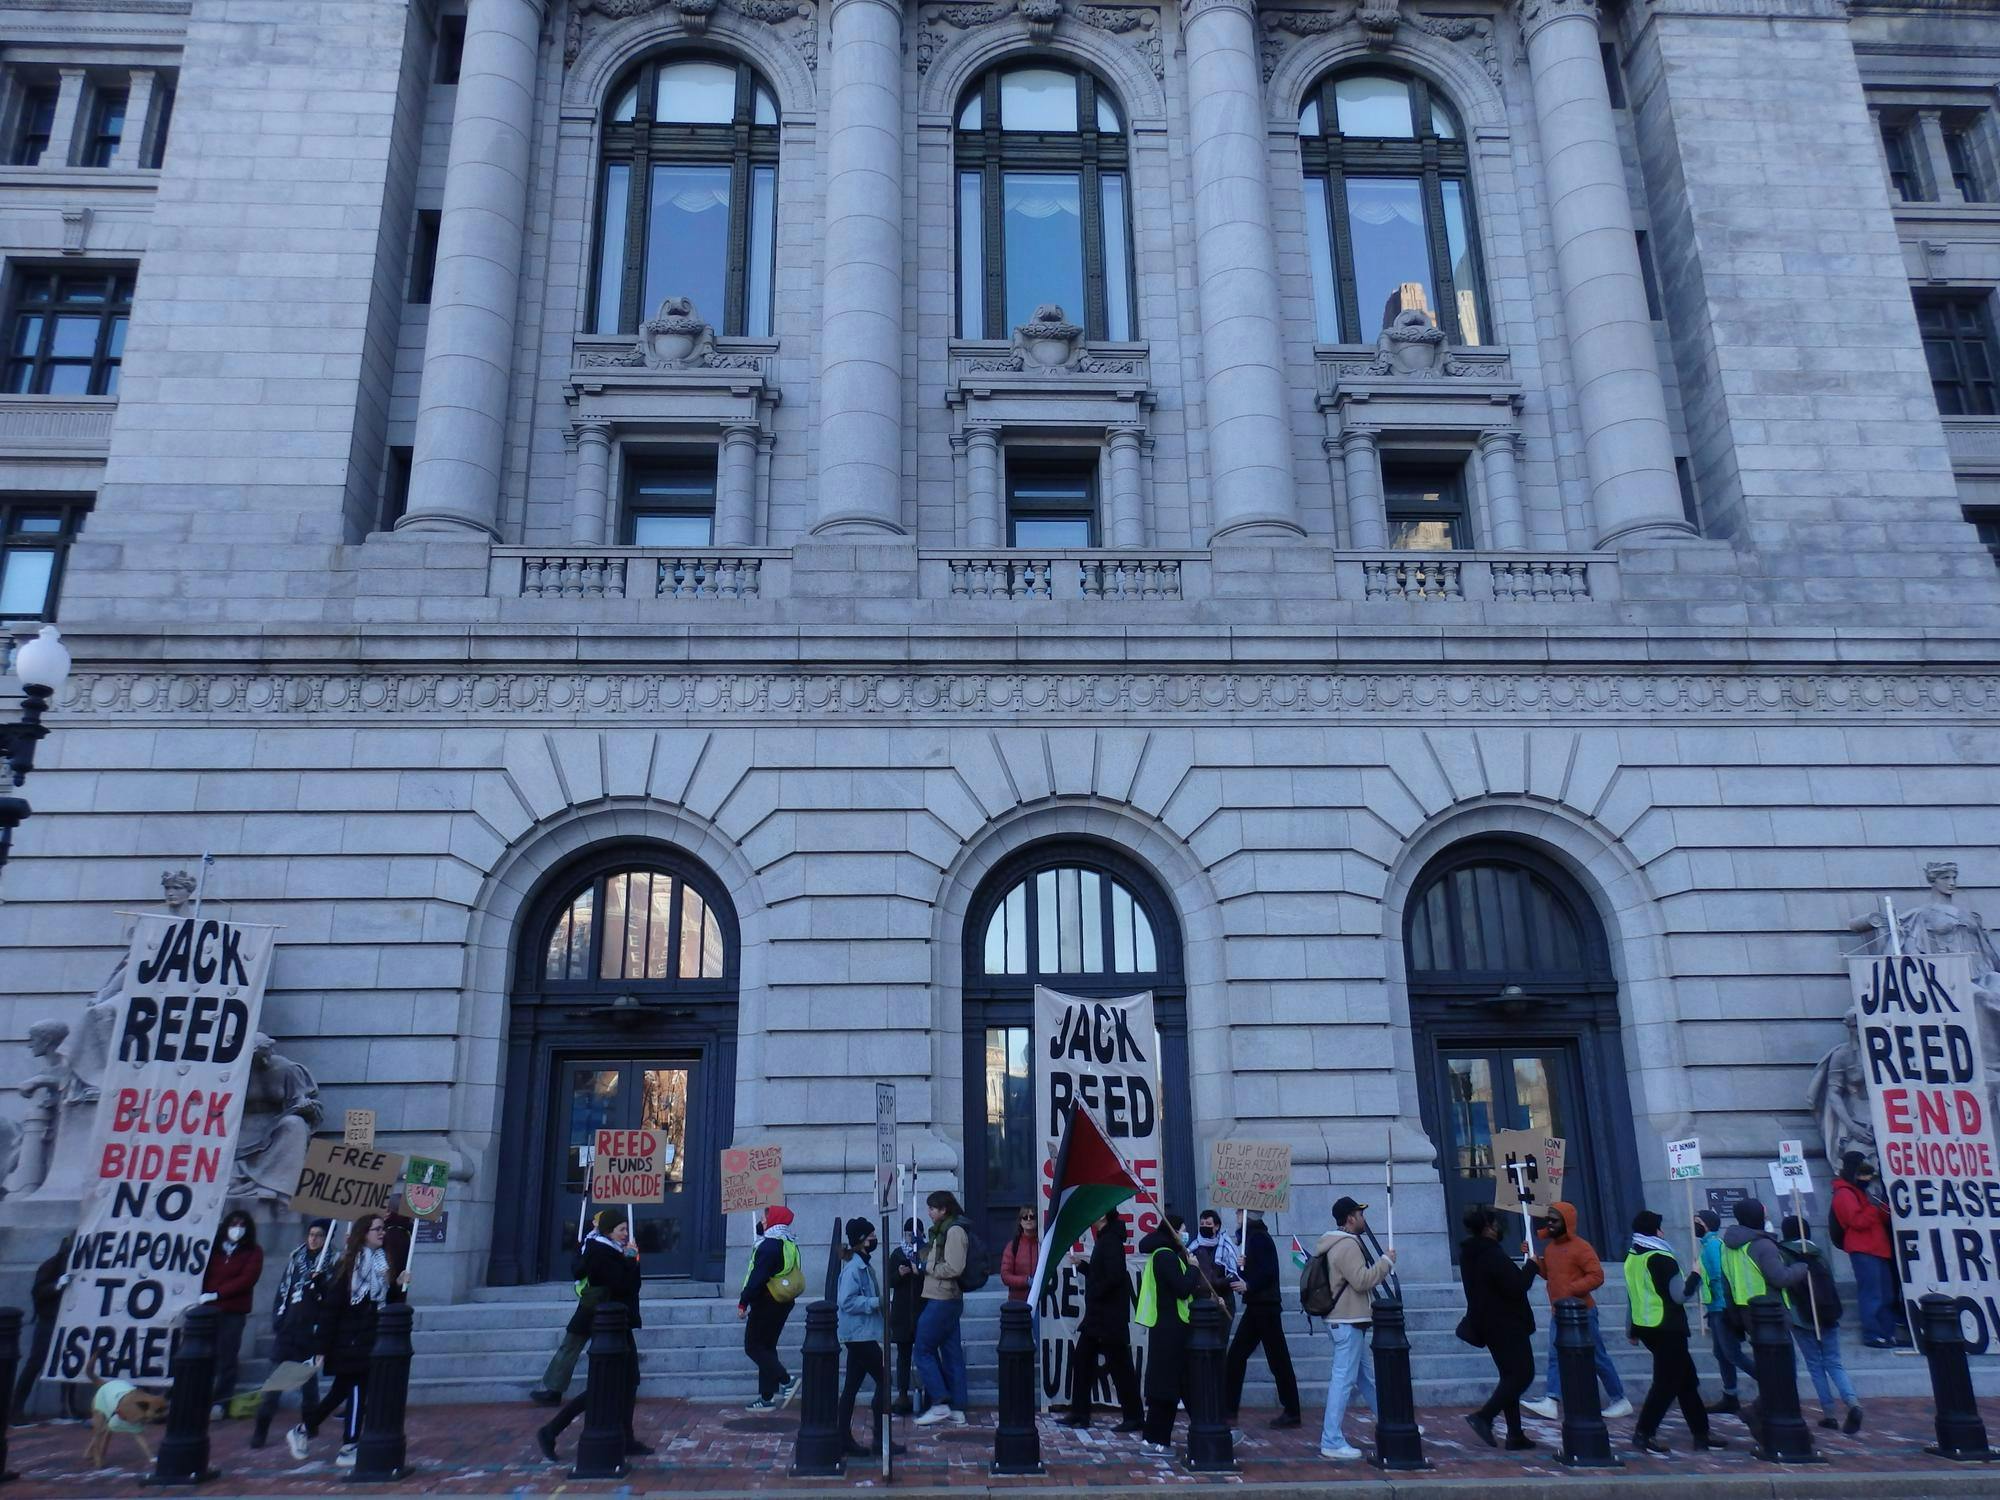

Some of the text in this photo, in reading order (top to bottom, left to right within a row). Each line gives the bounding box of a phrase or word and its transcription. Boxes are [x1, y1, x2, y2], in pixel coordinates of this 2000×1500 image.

[138, 919, 248, 986] JACK
[1861, 956, 1960, 1015] JACK
[119, 996, 248, 1063] REED
[1050, 1003, 1147, 1064] JACK
[1865, 1025, 1973, 1084] REED
[113, 1088, 232, 1137] BLOCK
[880, 1096, 893, 1114] STOP
[1050, 1071, 1154, 1138] REED
[1882, 1089, 1982, 1135] END
[100, 1143, 221, 1183] BIDEN
[328, 1146, 386, 1170] FREE
[598, 1131, 656, 1156] REED
[882, 1144, 892, 1162] RED
[1217, 1143, 1288, 1159] UP UP WITH
[1886, 1141, 1993, 1177] GENOCIDE
[609, 1157, 653, 1173] FUNDS
[725, 1171, 749, 1186] STOP
[751, 1157, 781, 1171] REED
[111, 1182, 192, 1221] NO
[295, 1168, 393, 1209] PALESTINE
[594, 1174, 661, 1199] GENOCIDE
[1889, 1179, 2000, 1219] CEASE
[72, 1231, 210, 1275] WEAPONS
[95, 1278, 163, 1319] TO
